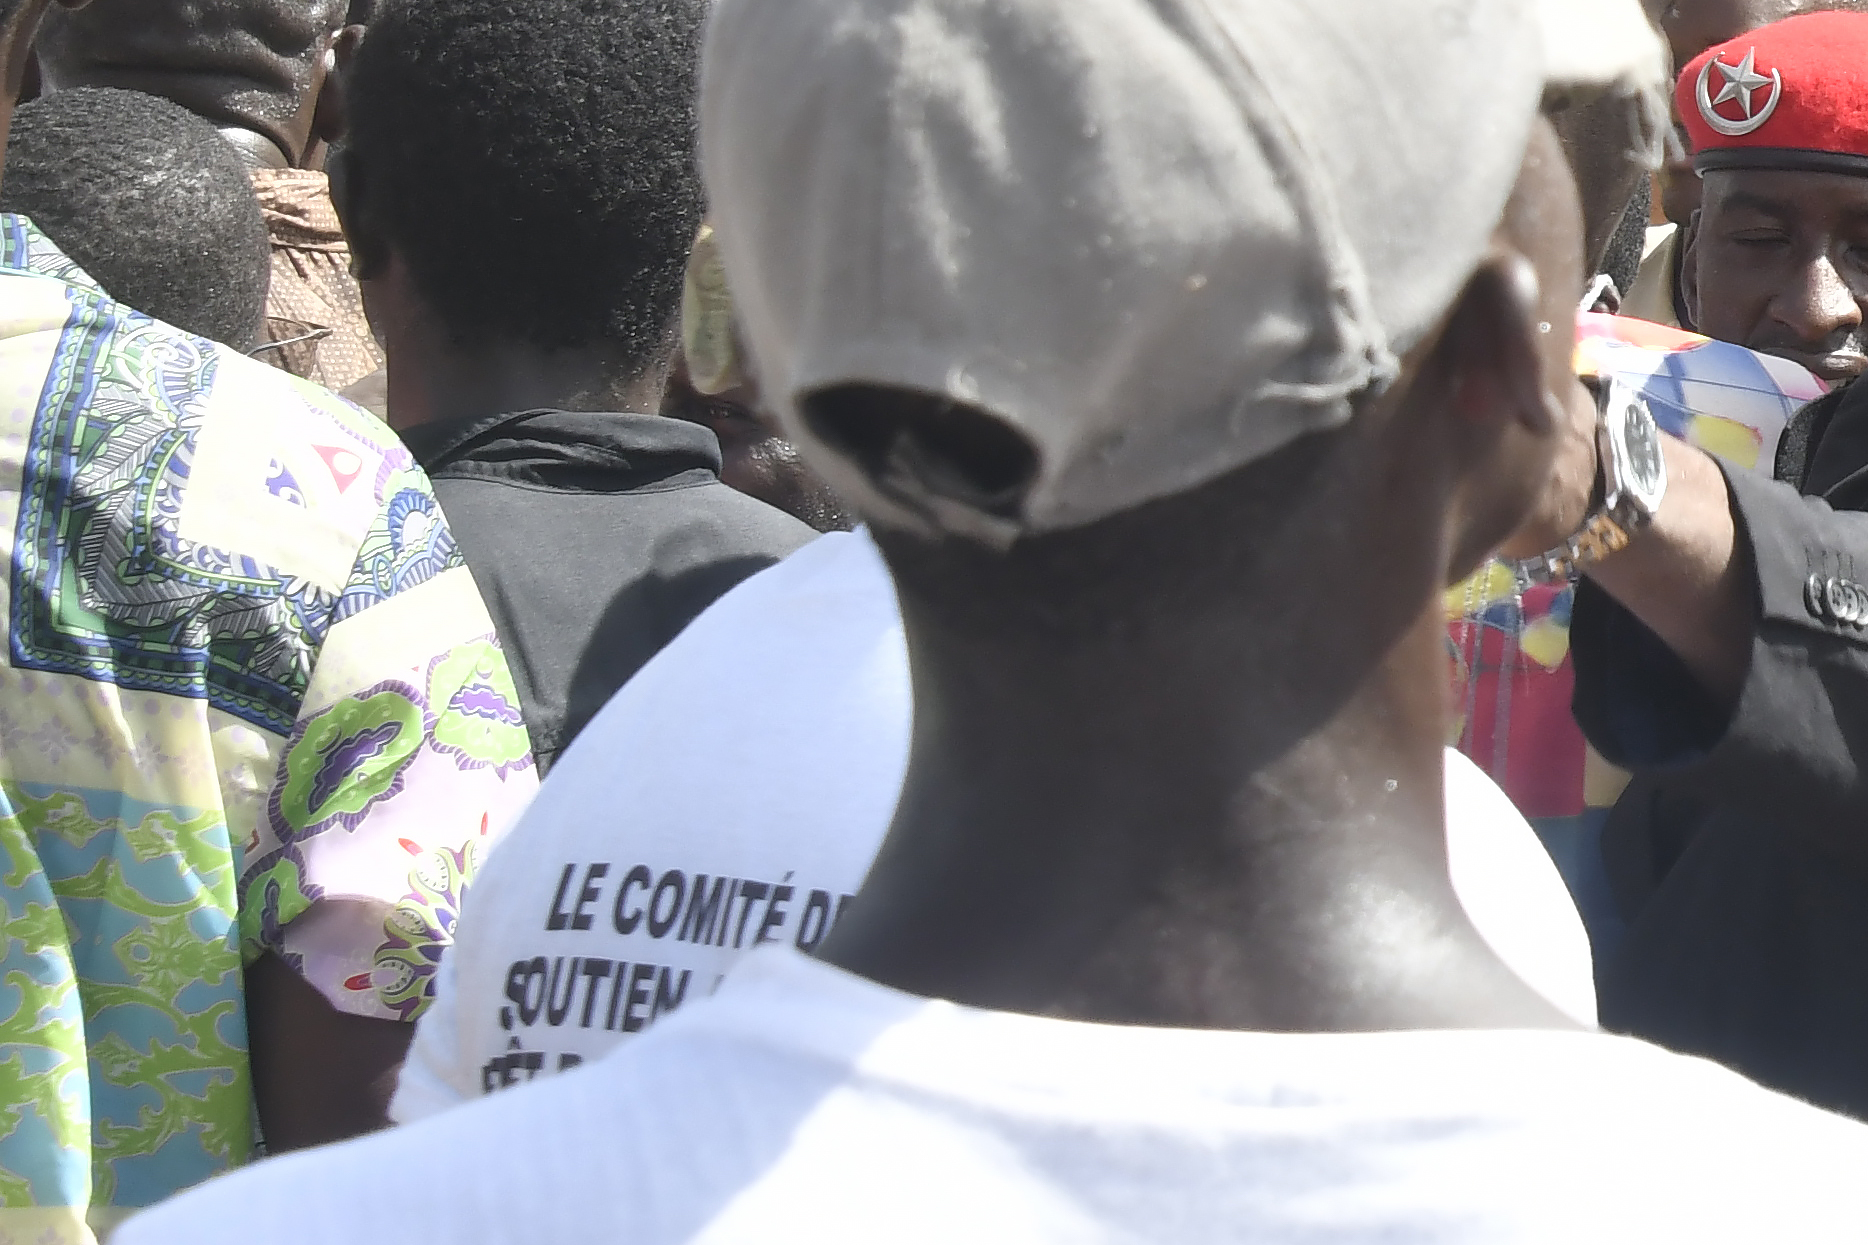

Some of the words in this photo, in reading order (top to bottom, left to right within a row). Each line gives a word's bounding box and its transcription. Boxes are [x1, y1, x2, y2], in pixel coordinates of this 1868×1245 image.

[546, 862, 610, 931] LE
[613, 864, 795, 949] COMITÉ
[500, 956, 692, 1032] SOUTIEN
